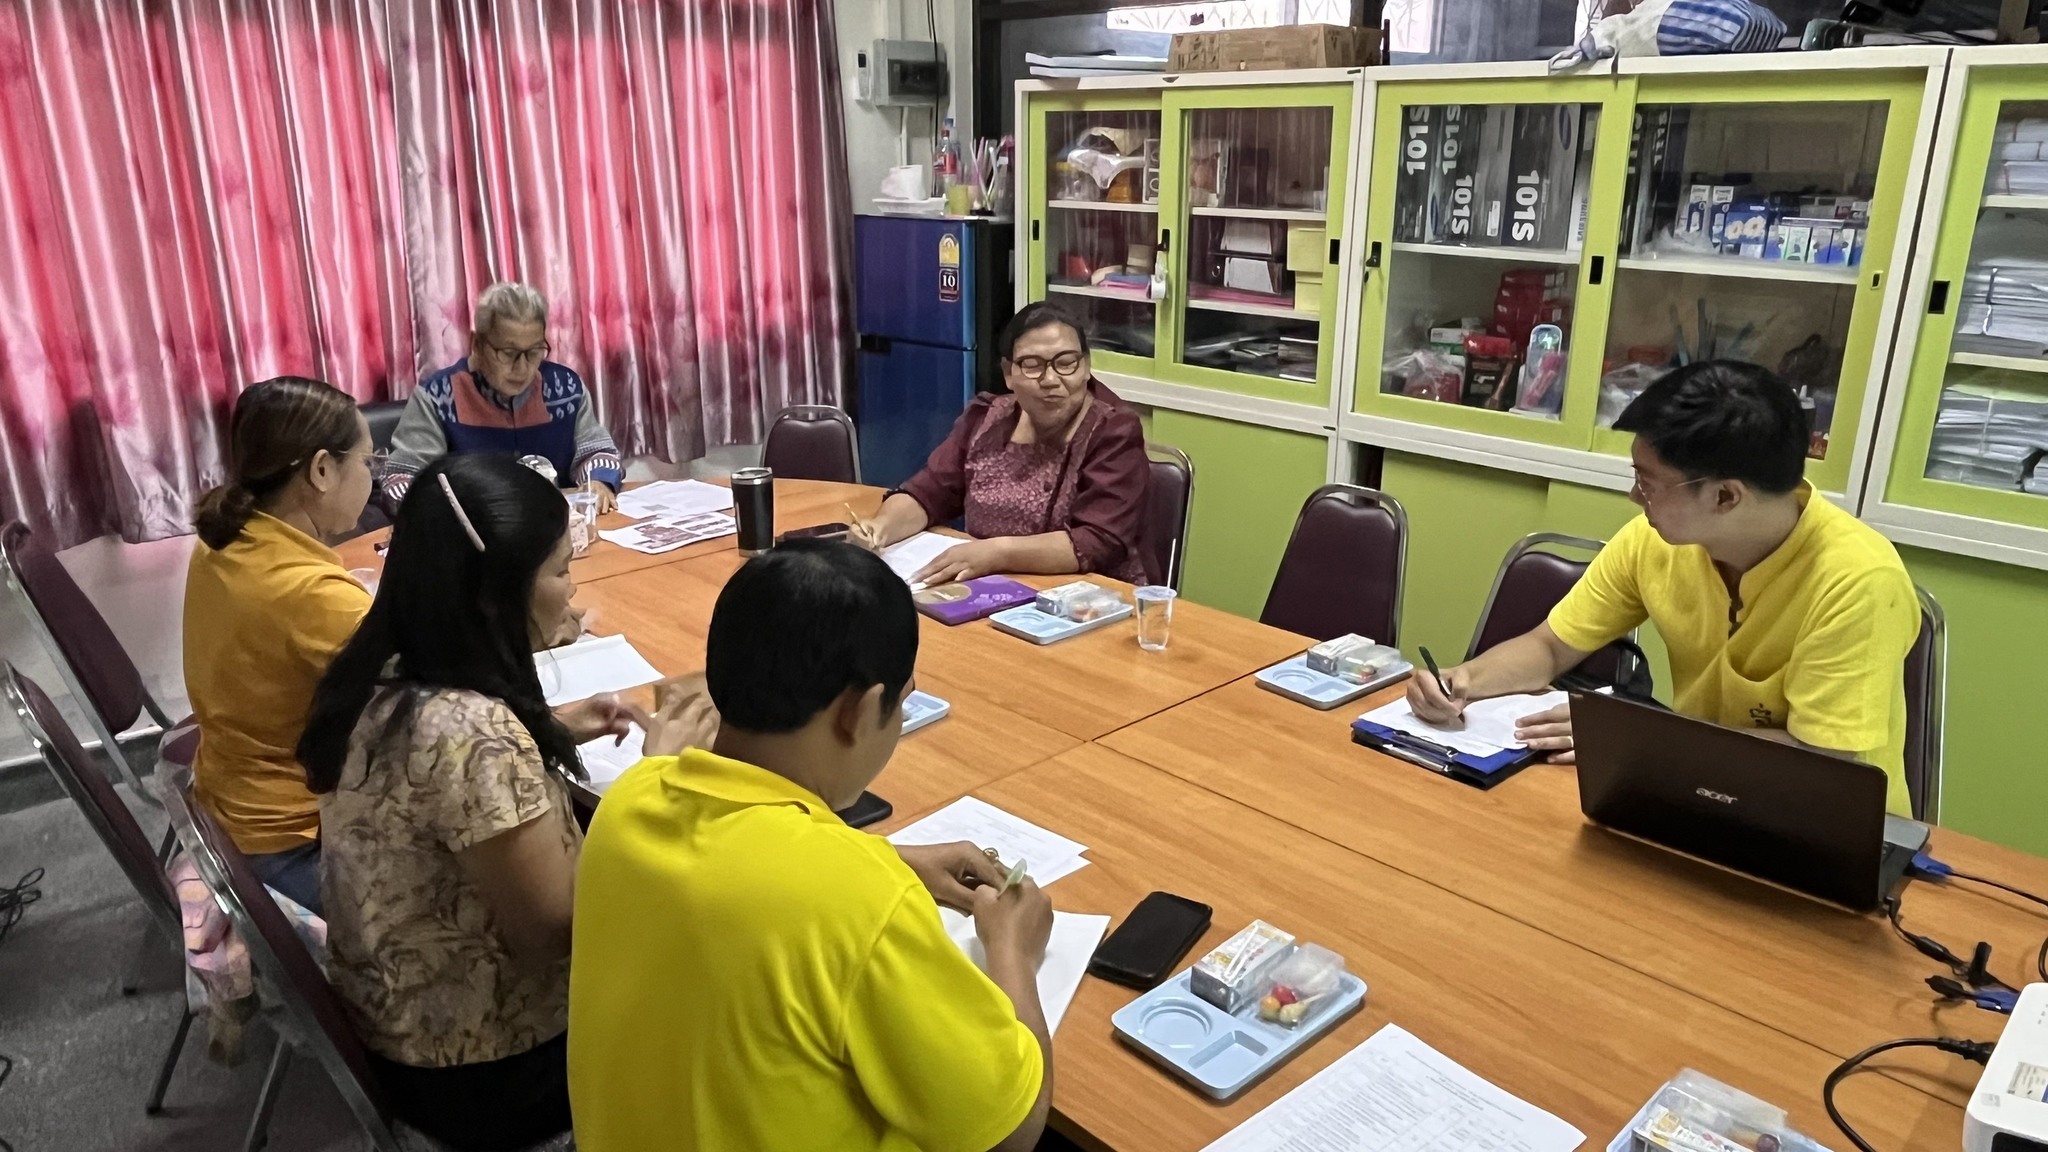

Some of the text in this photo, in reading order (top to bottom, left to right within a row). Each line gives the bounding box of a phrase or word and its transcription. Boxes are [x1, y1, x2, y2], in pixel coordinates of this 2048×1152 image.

[1406, 105, 1430, 175] 101S
[1442, 105, 1461, 175] 101S
[1451, 174, 1473, 235] 101S
[1511, 169, 1540, 242] 101S
[942, 274, 956, 287] 10
[1695, 786, 1738, 805] acer
